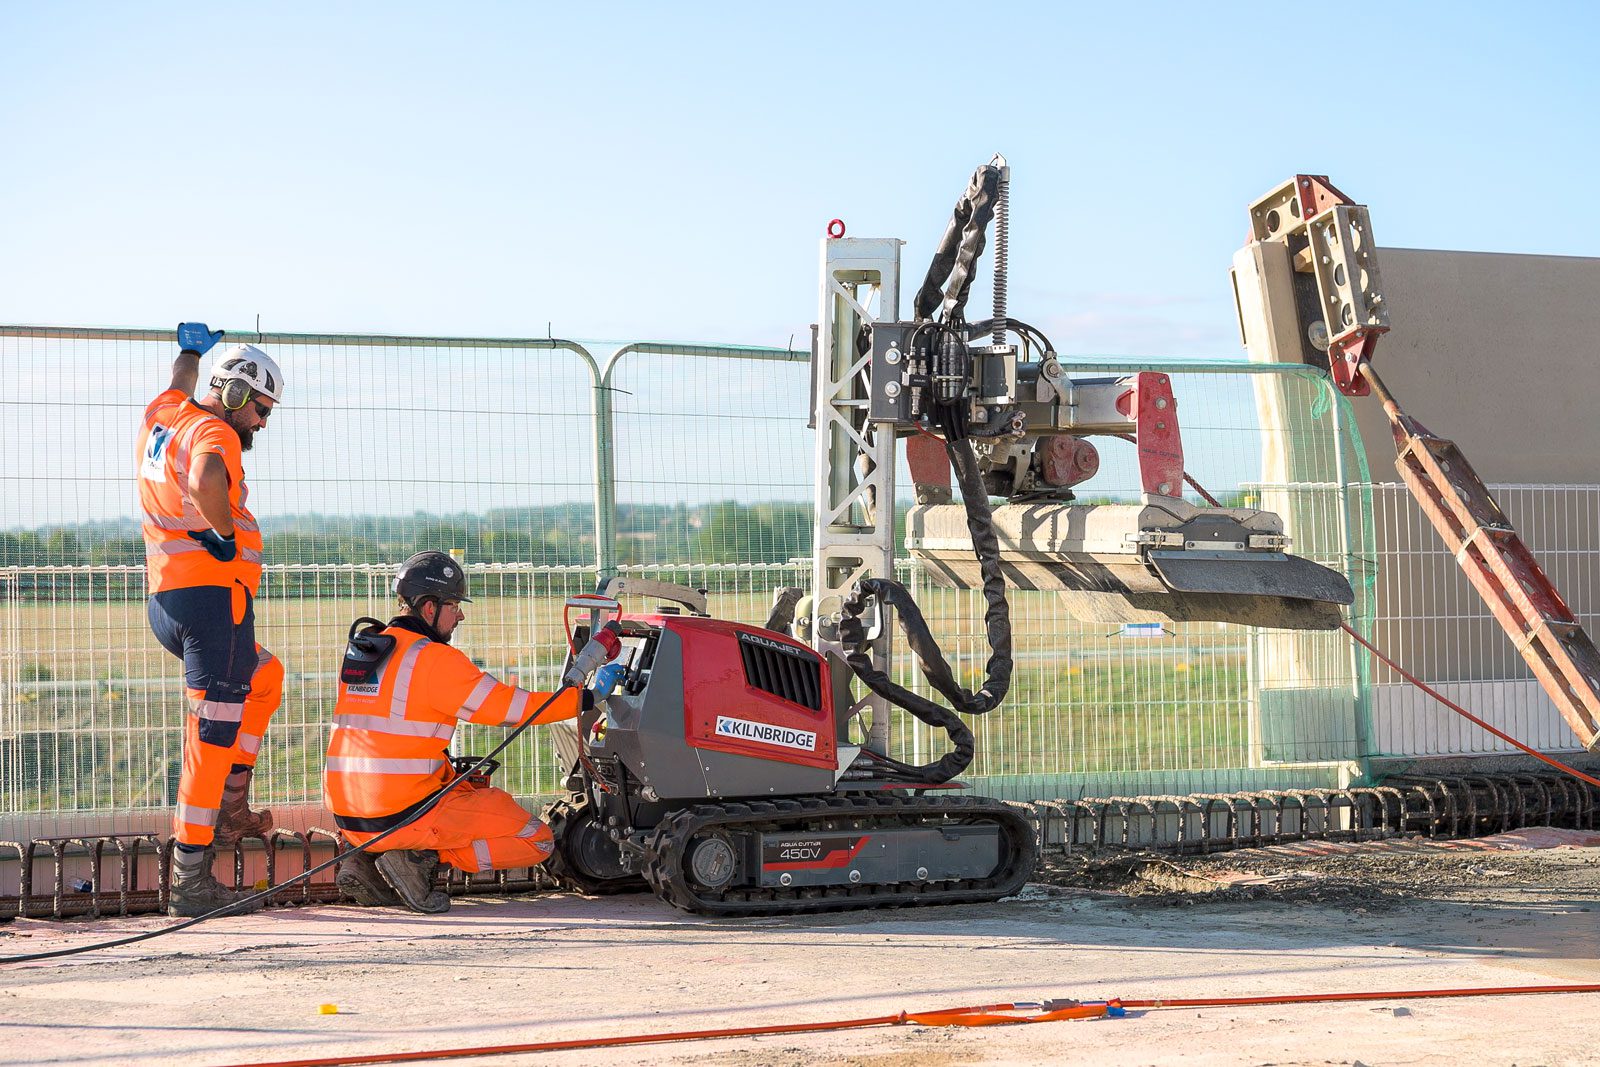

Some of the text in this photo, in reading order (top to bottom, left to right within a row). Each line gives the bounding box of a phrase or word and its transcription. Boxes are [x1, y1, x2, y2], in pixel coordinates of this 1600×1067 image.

[741, 633, 801, 655] AQUAJET
[348, 685, 378, 693] KILNBRIDGE
[732, 721, 814, 748] KILNBRIDGE
[780, 848, 821, 860] 450V
